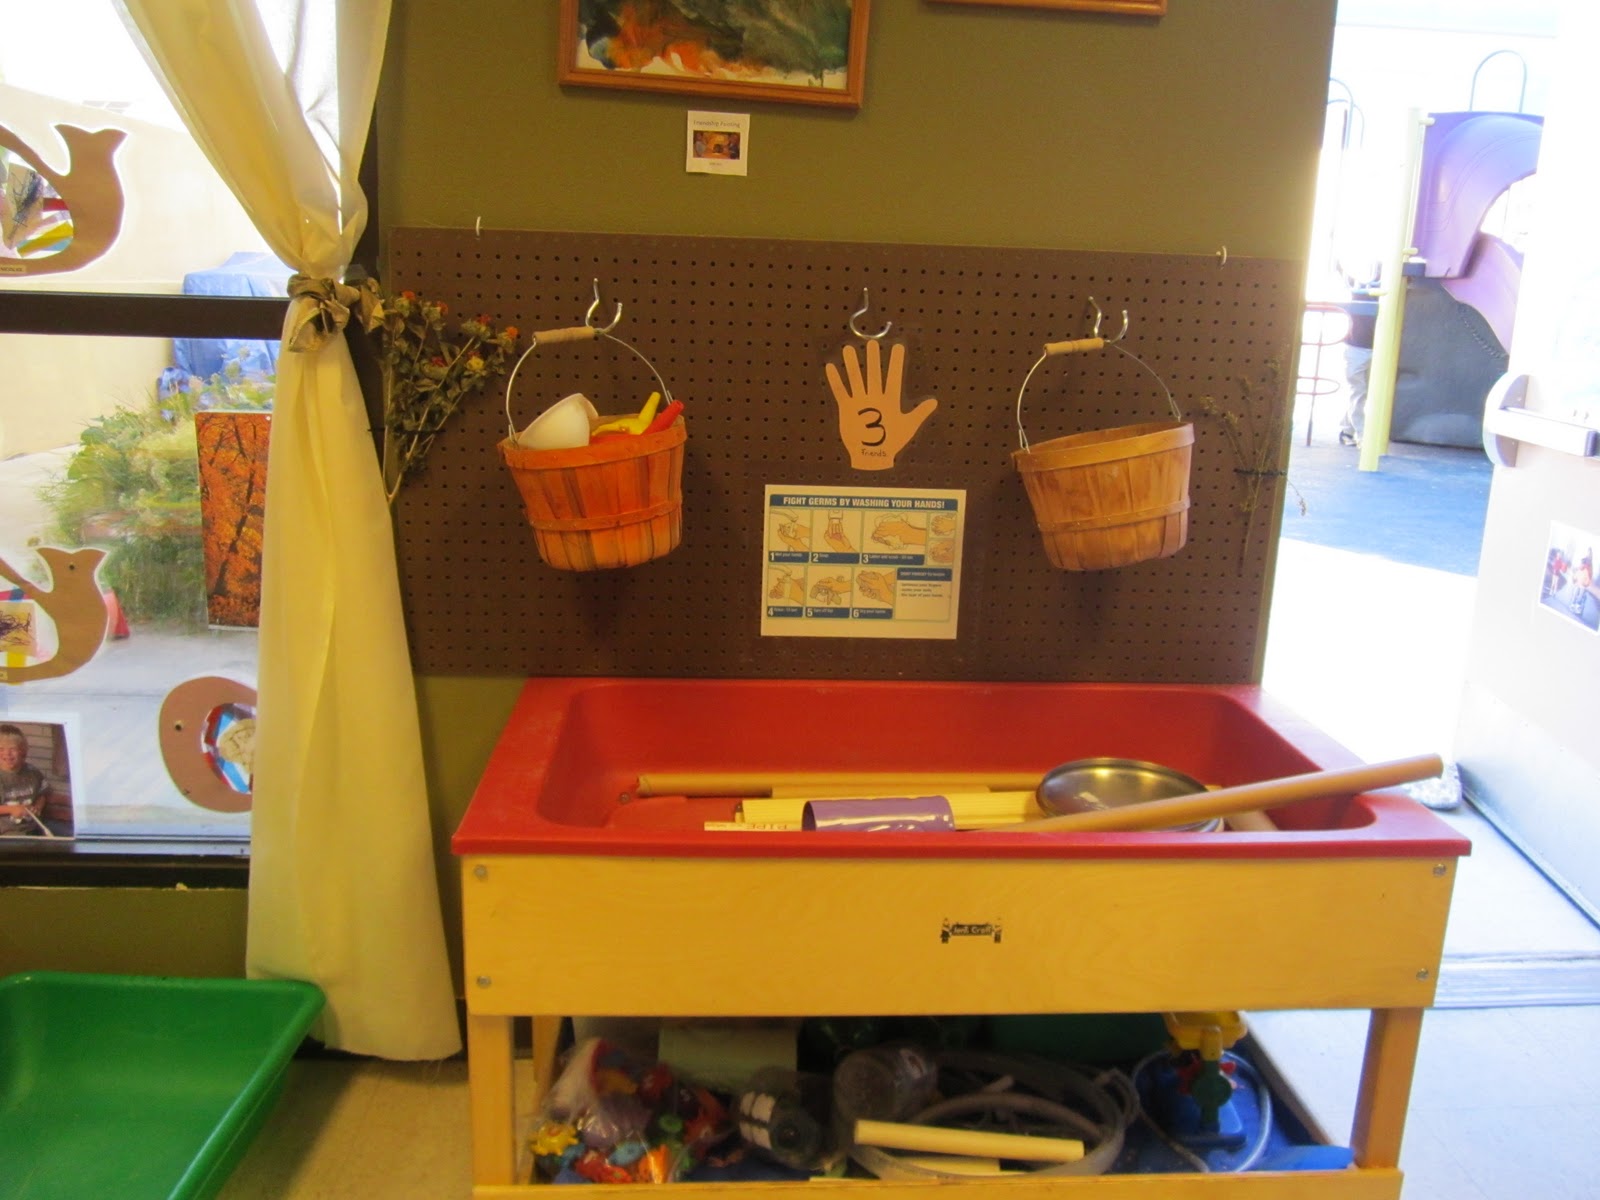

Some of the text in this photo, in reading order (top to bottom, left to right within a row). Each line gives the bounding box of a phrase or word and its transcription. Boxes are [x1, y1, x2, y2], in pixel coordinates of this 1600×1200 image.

[857, 407, 886, 447] 3
[783, 496, 945, 509] FIGHT GERMS BY WASHING YOUR HANDS!
[770, 552, 775, 561] 1
[812, 553, 819, 562] 2
[862, 554, 869, 564] 3
[768, 607, 774, 616] 4
[806, 607, 813, 617] 5
[852, 608, 860, 618] 6
